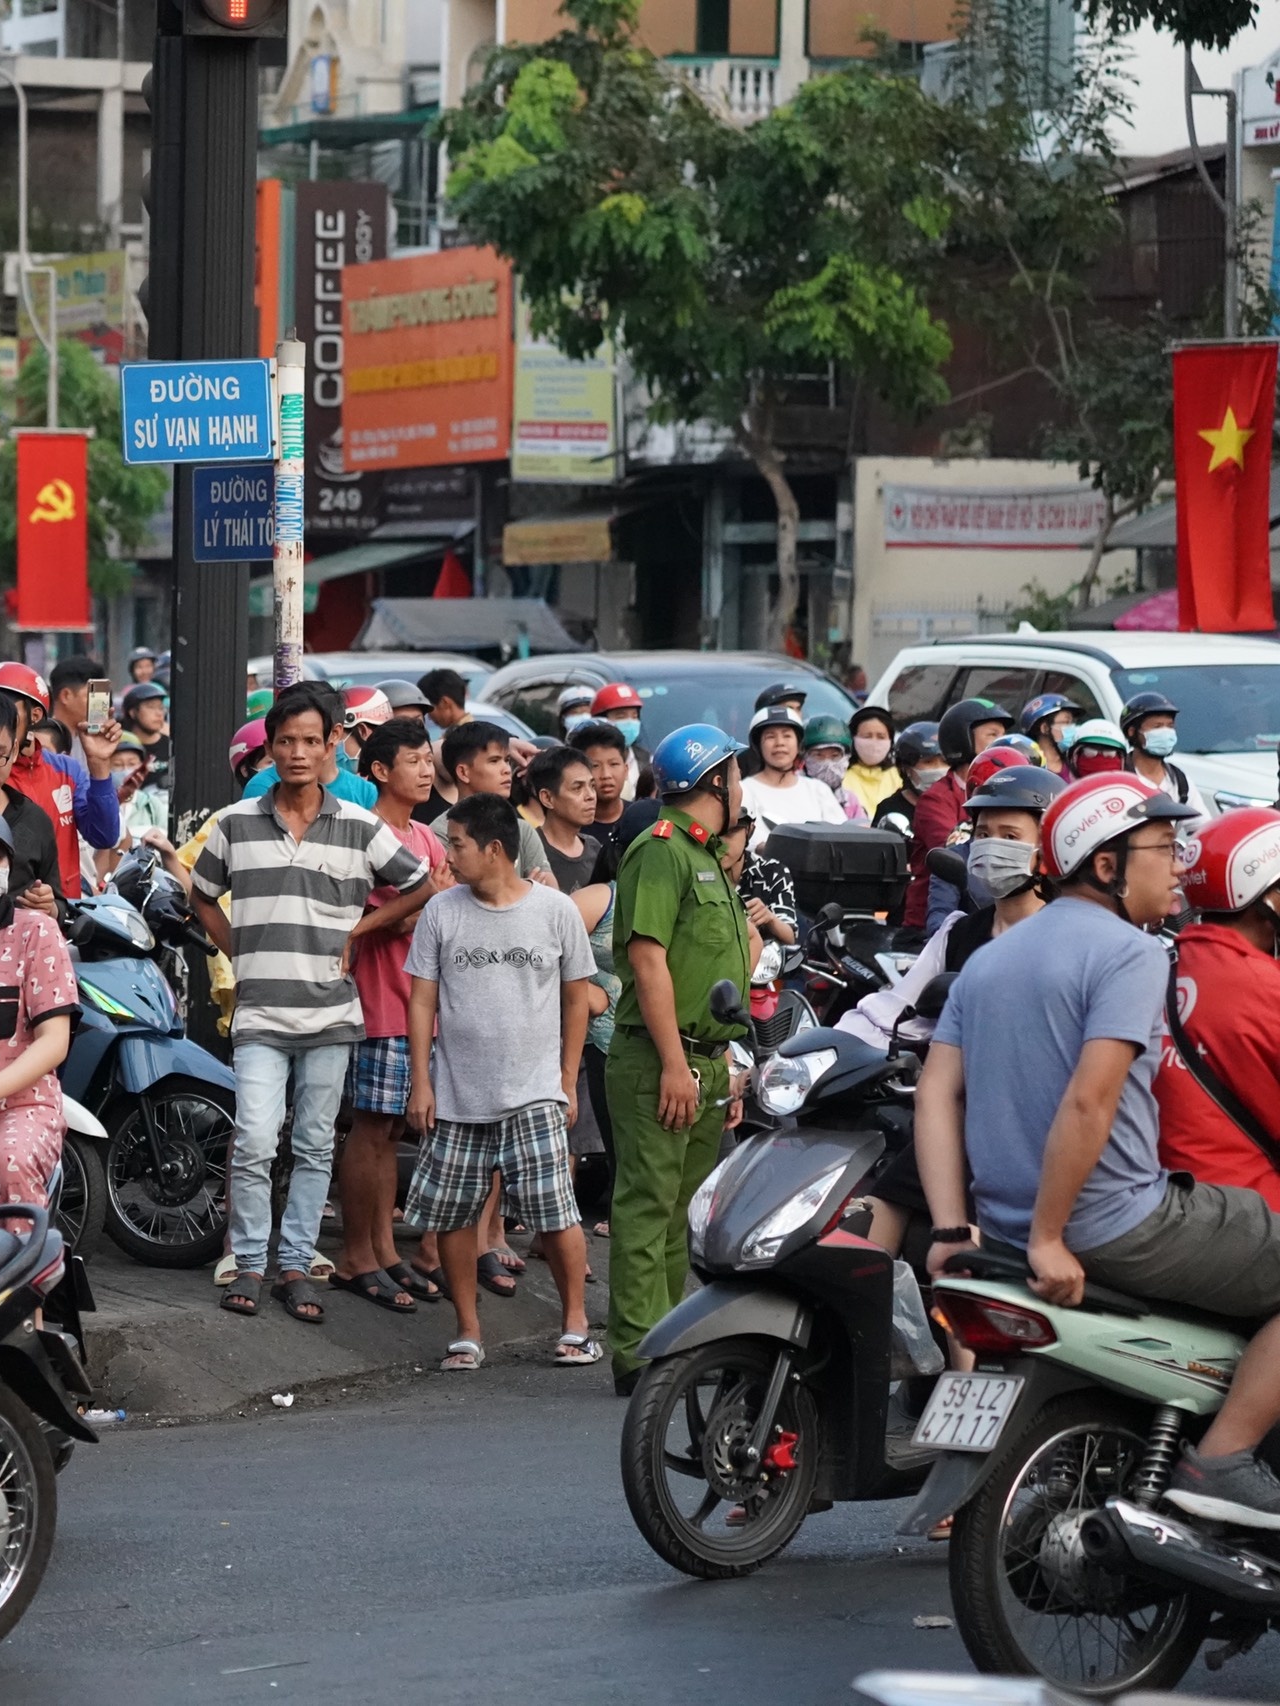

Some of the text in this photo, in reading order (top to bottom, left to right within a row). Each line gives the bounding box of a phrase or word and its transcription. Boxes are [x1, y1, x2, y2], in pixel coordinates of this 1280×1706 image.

[313, 209, 345, 408] COFFEE
[150, 372, 240, 403] ĐƯỜNG
[134, 412, 258, 452] SƯ VẠN HẠNH
[210, 474, 268, 504] ĐƯỜNG
[318, 488, 362, 512] 249
[204, 511, 220, 547] LÝ
[224, 511, 254, 547] THÁI
[1064, 809, 1105, 848] goviet
[454, 950, 544, 965] JEANS & DESIGN
[921, 1412, 1000, 1446] 471.17
